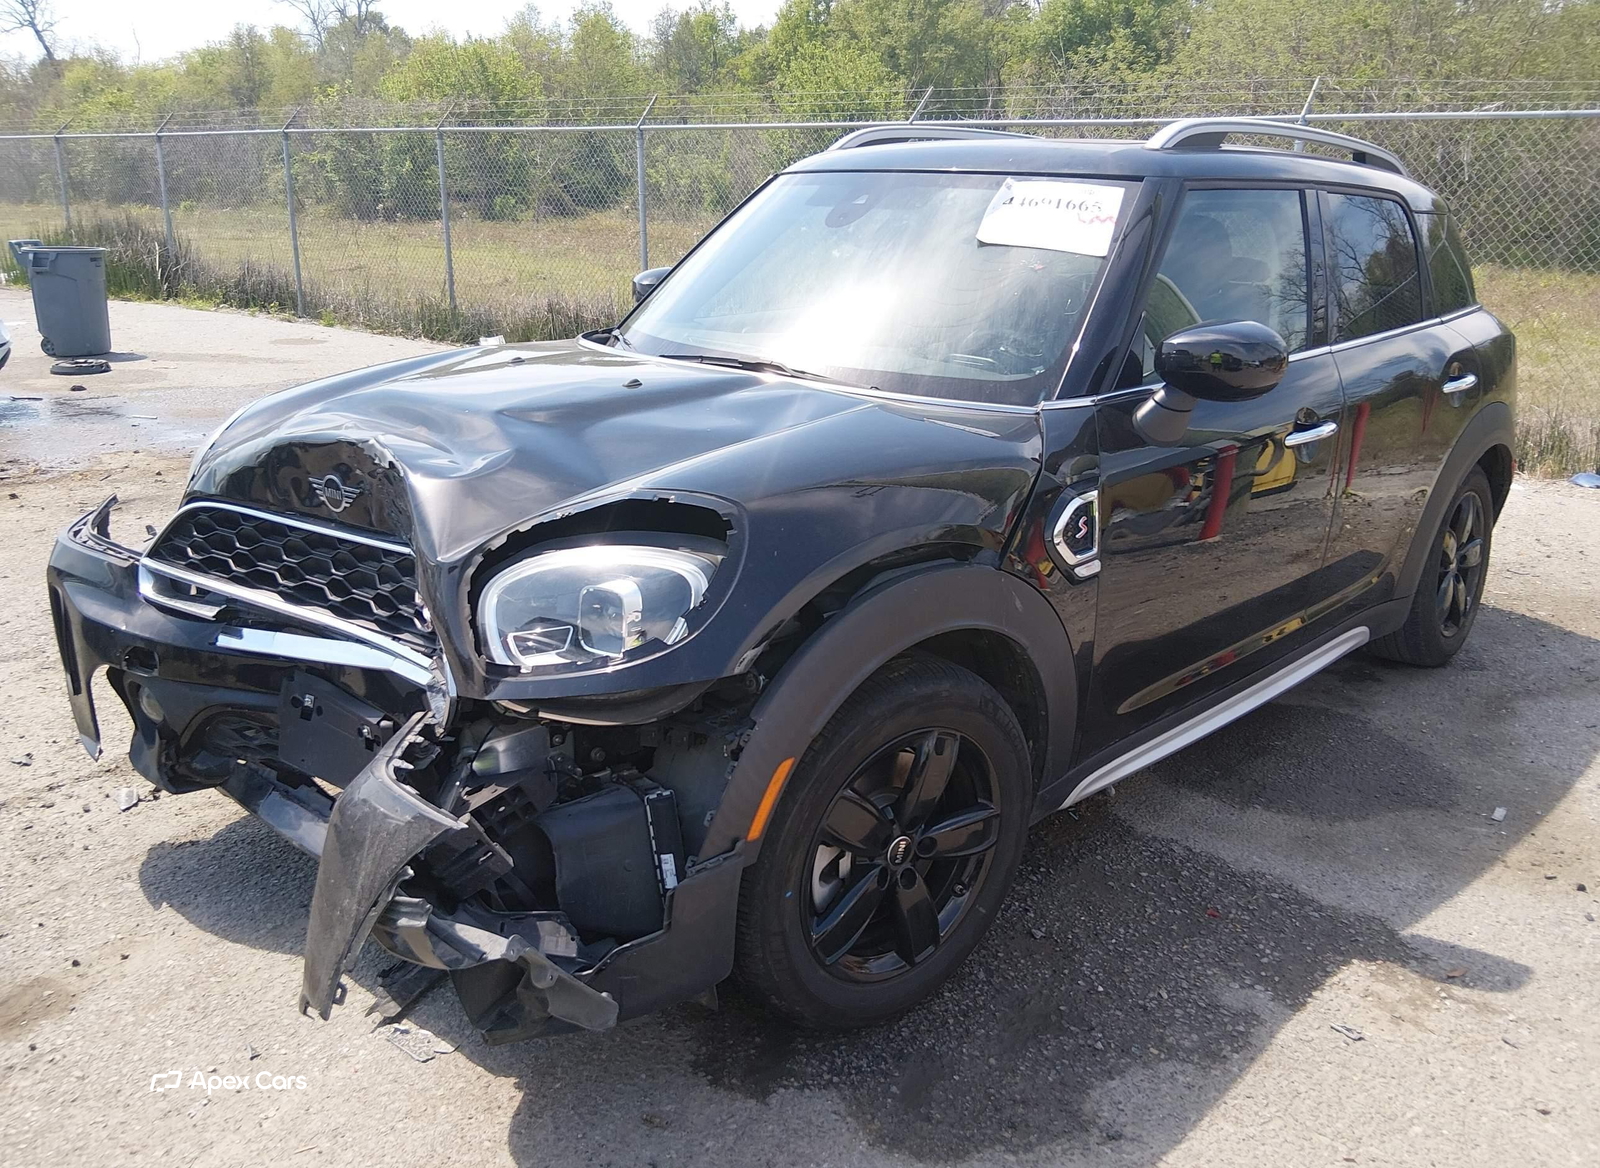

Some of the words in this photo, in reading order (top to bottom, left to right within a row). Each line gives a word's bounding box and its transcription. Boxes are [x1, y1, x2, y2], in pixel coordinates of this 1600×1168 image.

[324, 486, 343, 501] MINI
[1075, 515, 1089, 539] S
[894, 841, 907, 864] MINI
